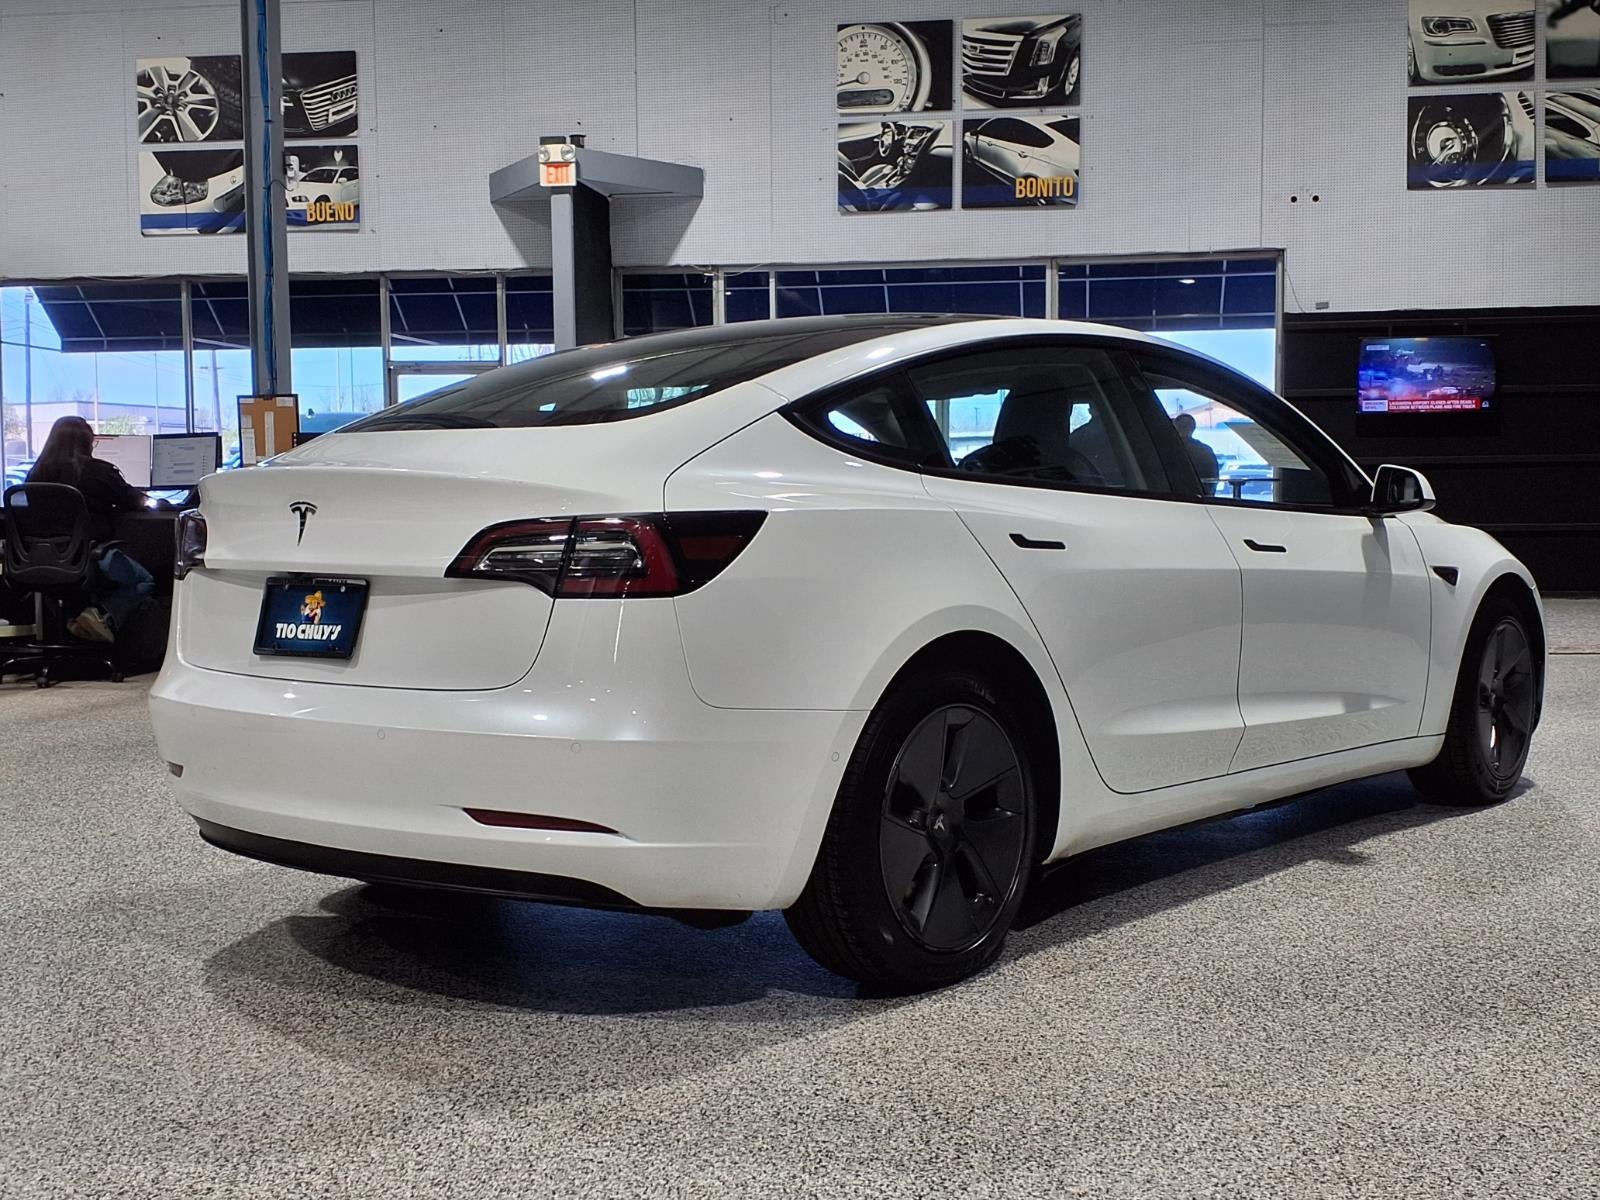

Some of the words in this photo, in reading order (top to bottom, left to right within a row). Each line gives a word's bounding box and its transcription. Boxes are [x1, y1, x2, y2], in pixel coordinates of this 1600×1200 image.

[547, 166, 569, 184] EXIT
[1015, 176, 1074, 198] BONITO
[307, 202, 355, 222] BUENO
[276, 623, 297, 639] TIO
[297, 624, 342, 641] CHUY'S
